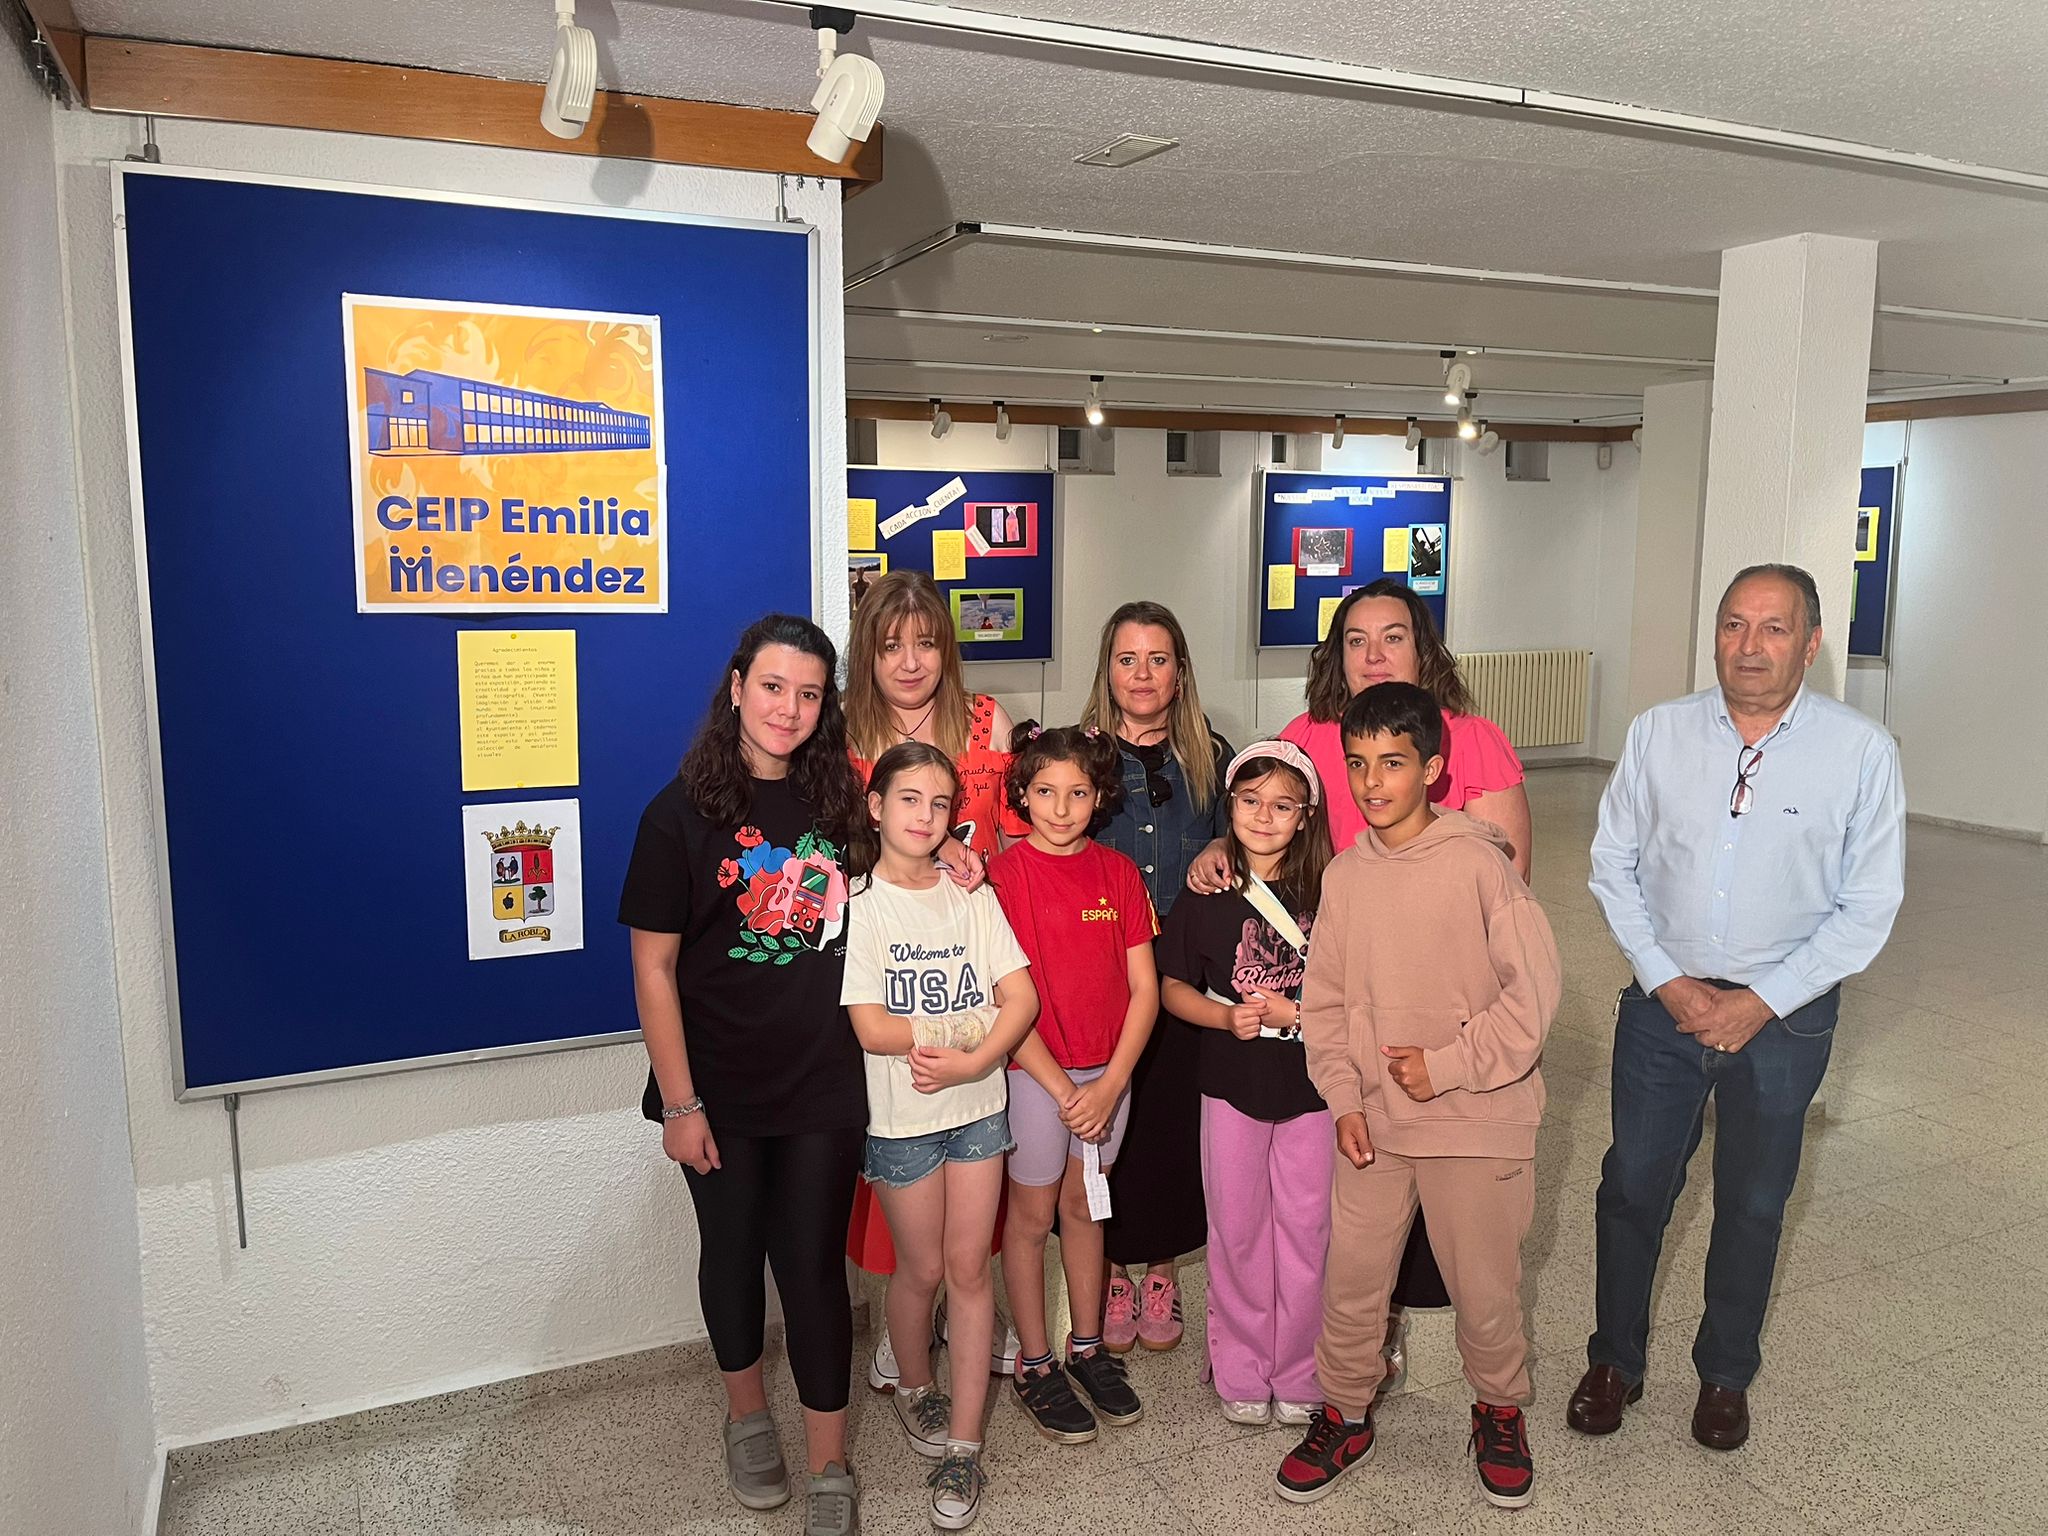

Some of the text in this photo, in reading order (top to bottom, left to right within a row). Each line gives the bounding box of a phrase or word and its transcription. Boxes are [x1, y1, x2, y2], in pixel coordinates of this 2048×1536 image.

[377, 495, 650, 536] CEIP Emilia
[389, 545, 645, 593] Menéndez
[504, 928, 547, 941] LA ROBLA
[890, 943, 966, 962] Welcome to
[885, 962, 985, 1015] USA
